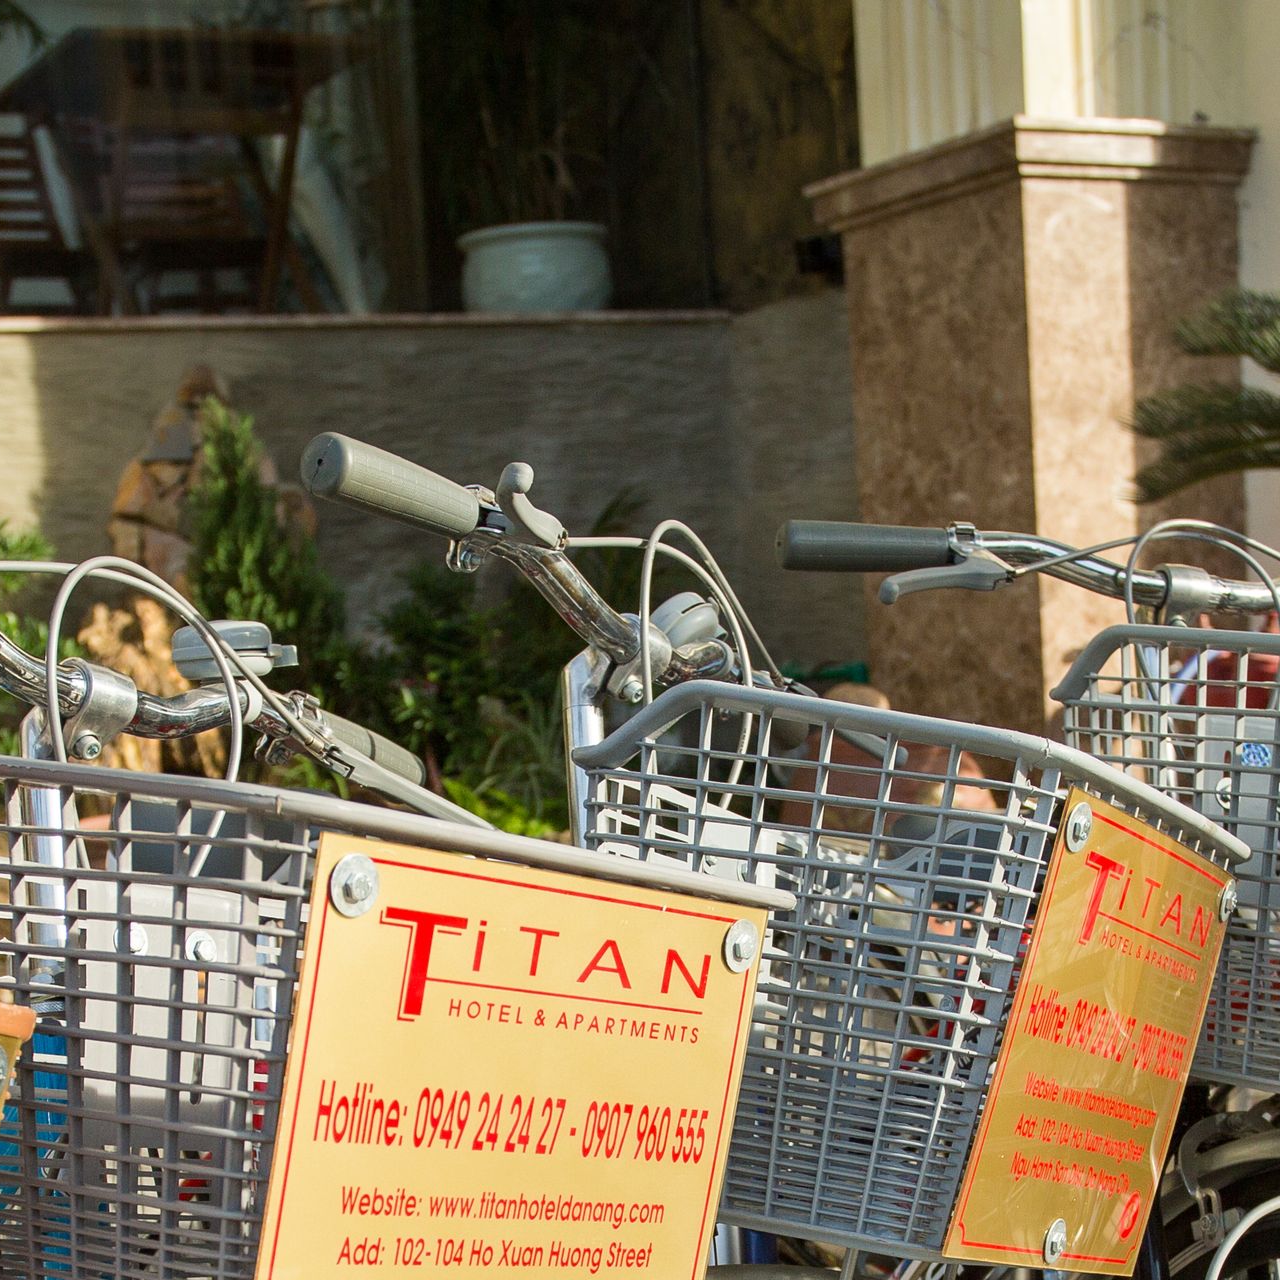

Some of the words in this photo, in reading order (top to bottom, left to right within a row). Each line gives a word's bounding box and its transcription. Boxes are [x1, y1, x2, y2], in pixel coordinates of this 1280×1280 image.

[1100, 930, 1134, 957] HOTEL
[449, 999, 522, 1024] HOTEL
[534, 1009, 545, 1026] &
[556, 1012, 698, 1044] APARTMENTS
[313, 1080, 407, 1146] Hotline:
[413, 1087, 471, 1149] 0949
[472, 1092, 503, 1151] 24
[504, 1094, 535, 1153] 24
[535, 1097, 566, 1154] 27
[582, 1101, 634, 1159] 0907
[634, 1105, 671, 1162] 960
[672, 1108, 709, 1164] 555
[342, 1186, 422, 1216] Website:
[430, 1192, 664, 1230] www.titanhoteldanang.com
[337, 1237, 384, 1265] Add:
[394, 1238, 464, 1266] 102-104
[469, 1240, 493, 1266] Ho
[498, 1240, 543, 1267] Xuan
[548, 1241, 603, 1274] Huong
[606, 1242, 652, 1268] Street
